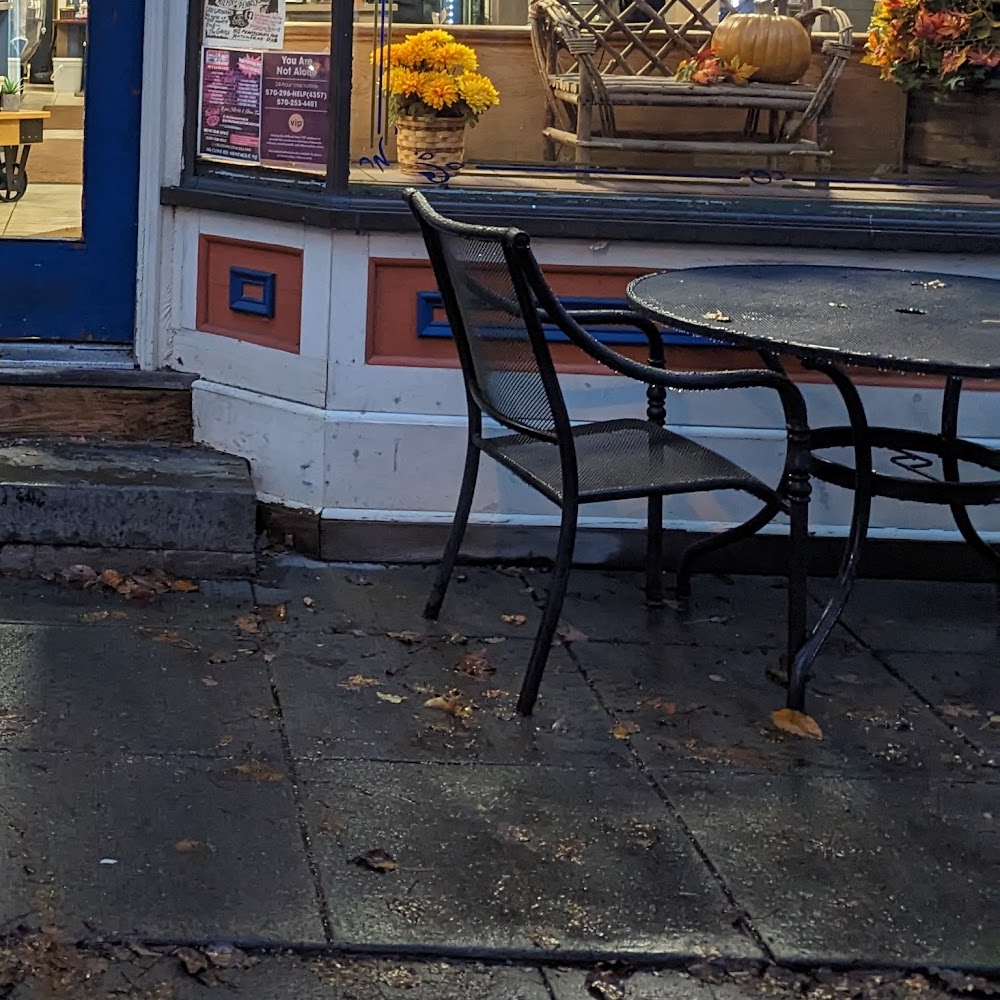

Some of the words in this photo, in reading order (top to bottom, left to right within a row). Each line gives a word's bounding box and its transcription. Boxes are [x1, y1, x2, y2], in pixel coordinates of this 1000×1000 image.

[281, 55, 297, 65] You
[298, 56, 313, 66] Are
[276, 66, 292, 75] Not
[293, 67, 317, 77] Alone
[290, 119, 302, 128] vip
